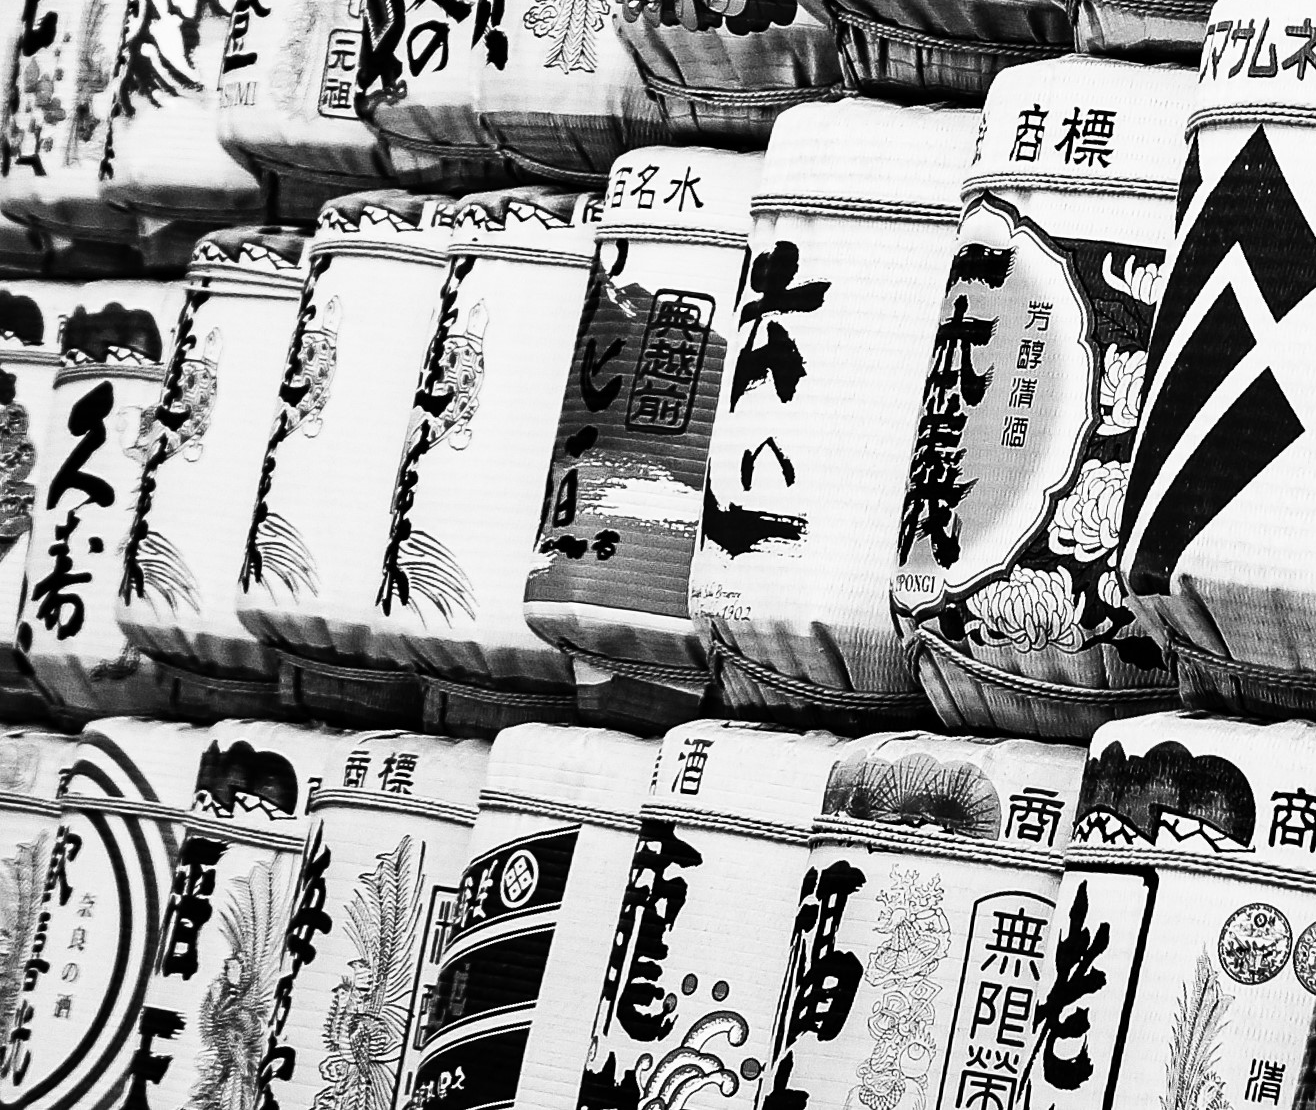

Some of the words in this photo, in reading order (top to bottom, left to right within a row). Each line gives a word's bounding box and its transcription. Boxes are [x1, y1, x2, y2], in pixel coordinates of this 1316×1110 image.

[1008, 103, 1117, 169] 商標
[1000, 299, 1054, 449] 芳醇清酒
